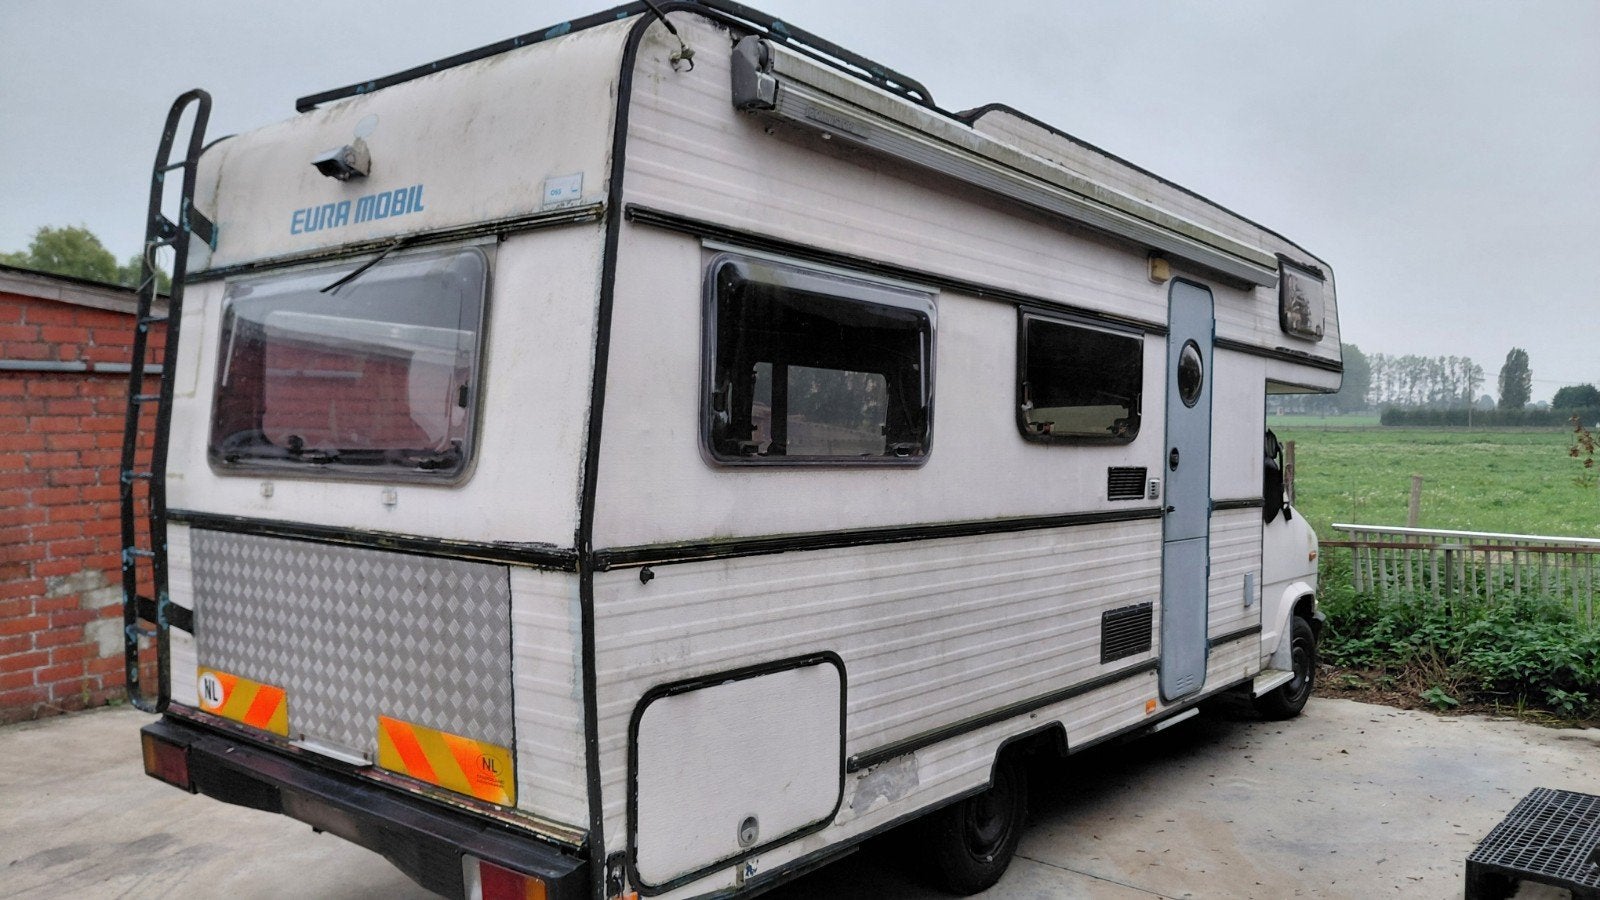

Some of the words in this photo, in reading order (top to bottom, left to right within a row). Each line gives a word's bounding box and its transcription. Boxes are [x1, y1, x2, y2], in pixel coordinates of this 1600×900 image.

[290, 201, 351, 235] EURA
[354, 184, 424, 223] MOBIL
[204, 678, 218, 702] NL
[482, 756, 497, 773] NL
